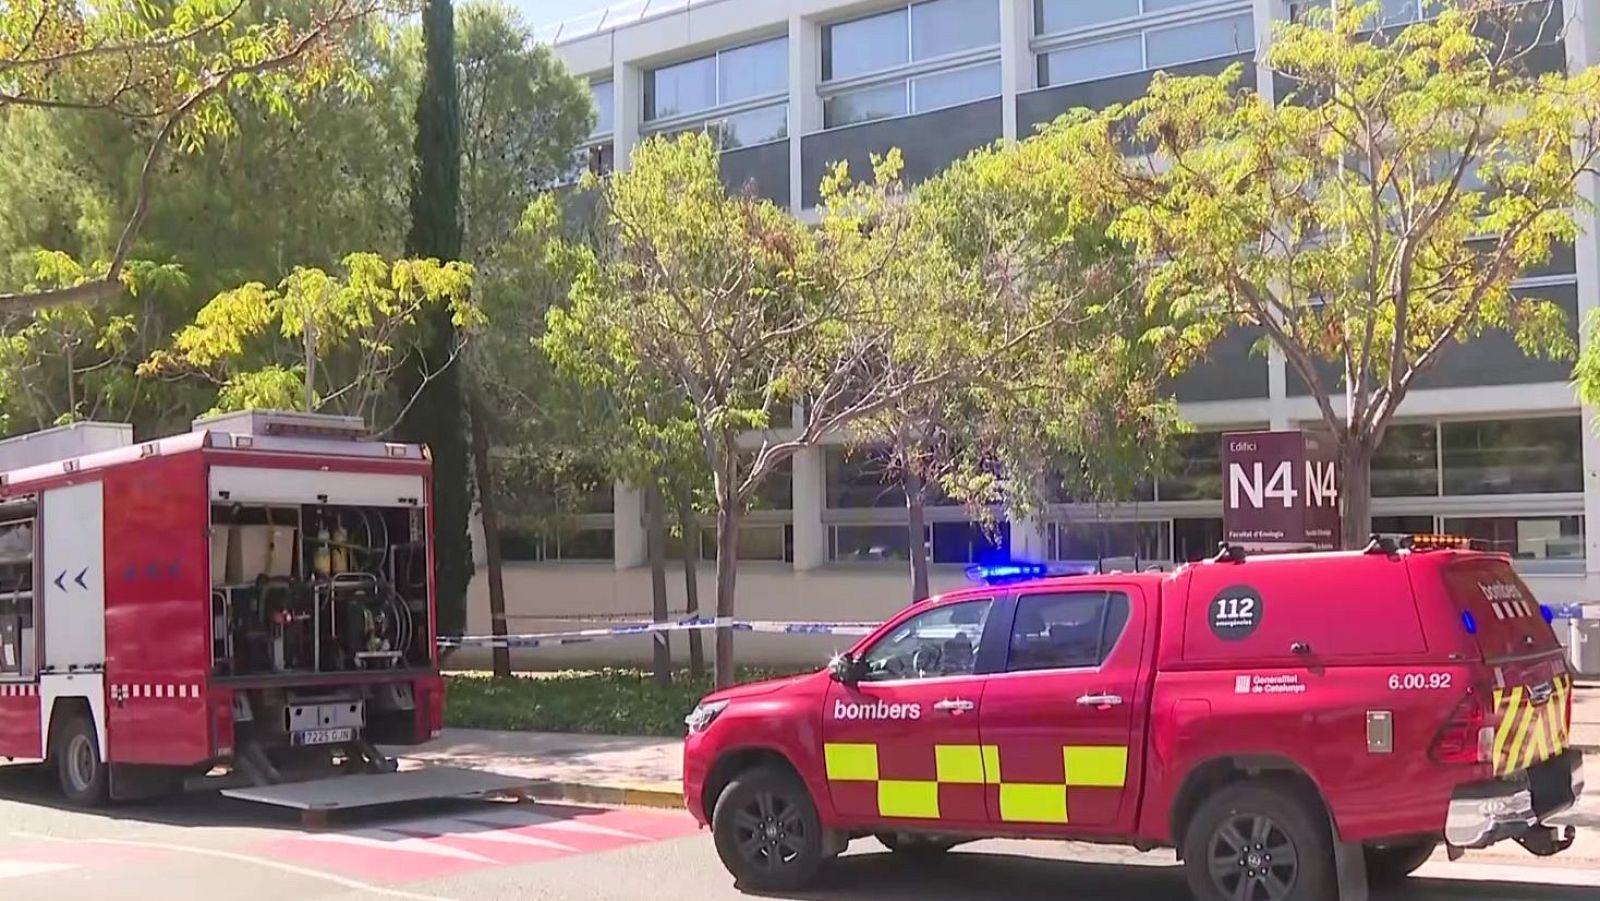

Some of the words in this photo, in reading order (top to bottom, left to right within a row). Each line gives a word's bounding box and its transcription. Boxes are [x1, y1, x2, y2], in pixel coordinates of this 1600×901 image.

[1230, 442, 1257, 452] Edifici
[1229, 461, 1298, 509] N4
[1305, 460, 1338, 507] N4
[1478, 581, 1522, 601] bombers
[1216, 598, 1254, 618] 112
[1253, 674, 1298, 684] Generalitat
[1388, 672, 1452, 689] 6.00.92
[1252, 684, 1263, 693] de
[1264, 684, 1306, 693] Catalunya
[834, 699, 921, 719] bombers
[307, 731, 329, 743] 7225
